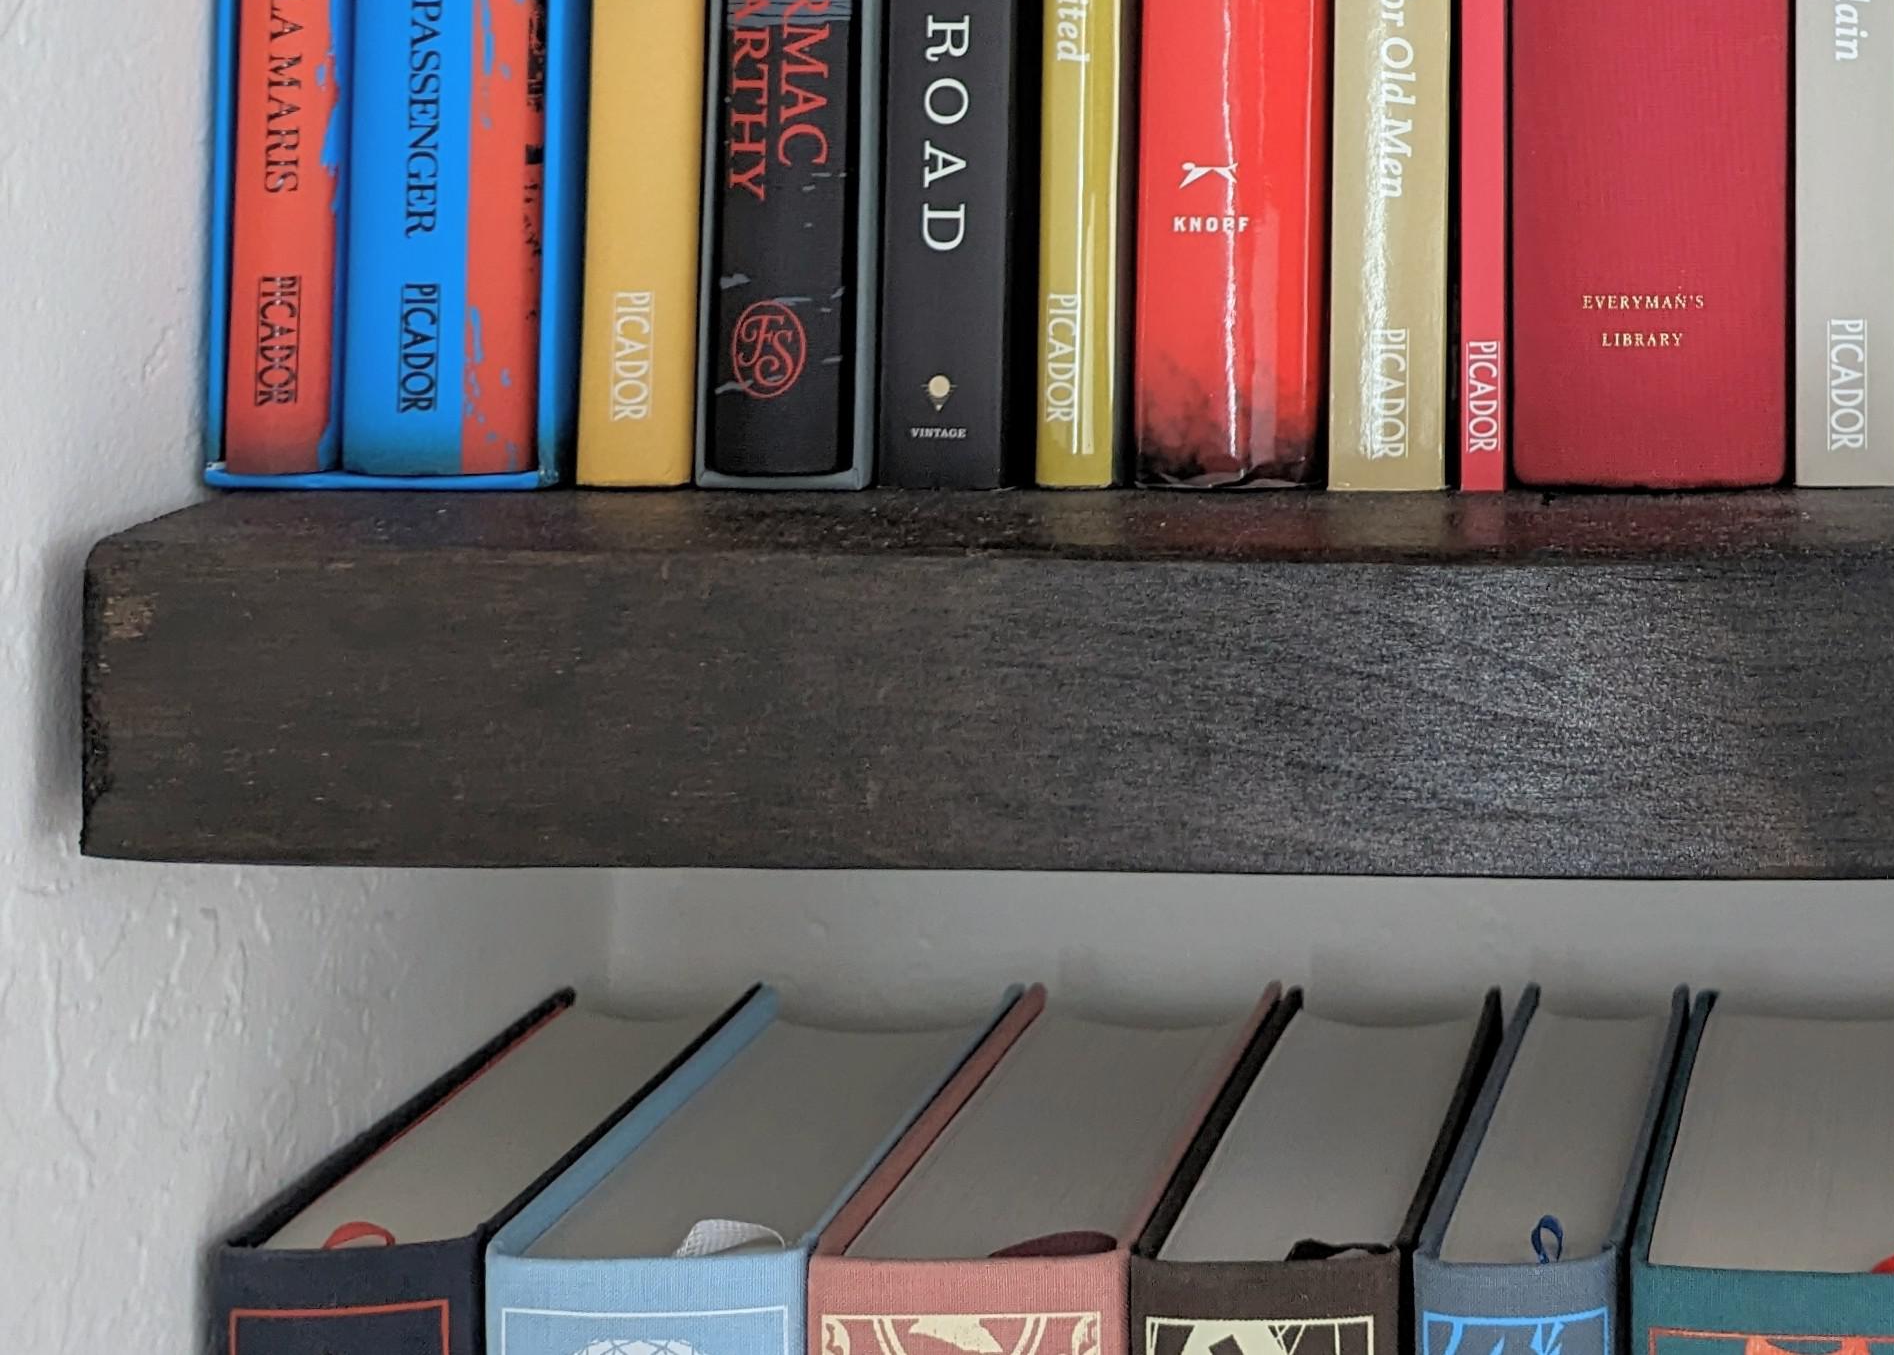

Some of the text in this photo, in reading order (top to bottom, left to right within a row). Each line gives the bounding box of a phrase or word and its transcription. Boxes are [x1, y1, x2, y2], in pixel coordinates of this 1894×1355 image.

[264, 54, 304, 194] MARIS
[922, 15, 971, 251] ROAD
[1379, 37, 1417, 102] Old
[1378, 117, 1414, 198] Men
[1173, 217, 1249, 232] KNOPF
[258, 275, 302, 406] PICADOR
[399, 282, 440, 413] PICADOR
[611, 291, 654, 422] PICADOR
[1046, 293, 1078, 423] PICADOR
[1372, 328, 1409, 460] PICADOR
[1466, 341, 1501, 452] PICADOR
[1602, 333, 1684, 347] LIBRARY
[1827, 318, 1867, 451] PICADOR
[911, 428, 967, 439] VINTAGE
